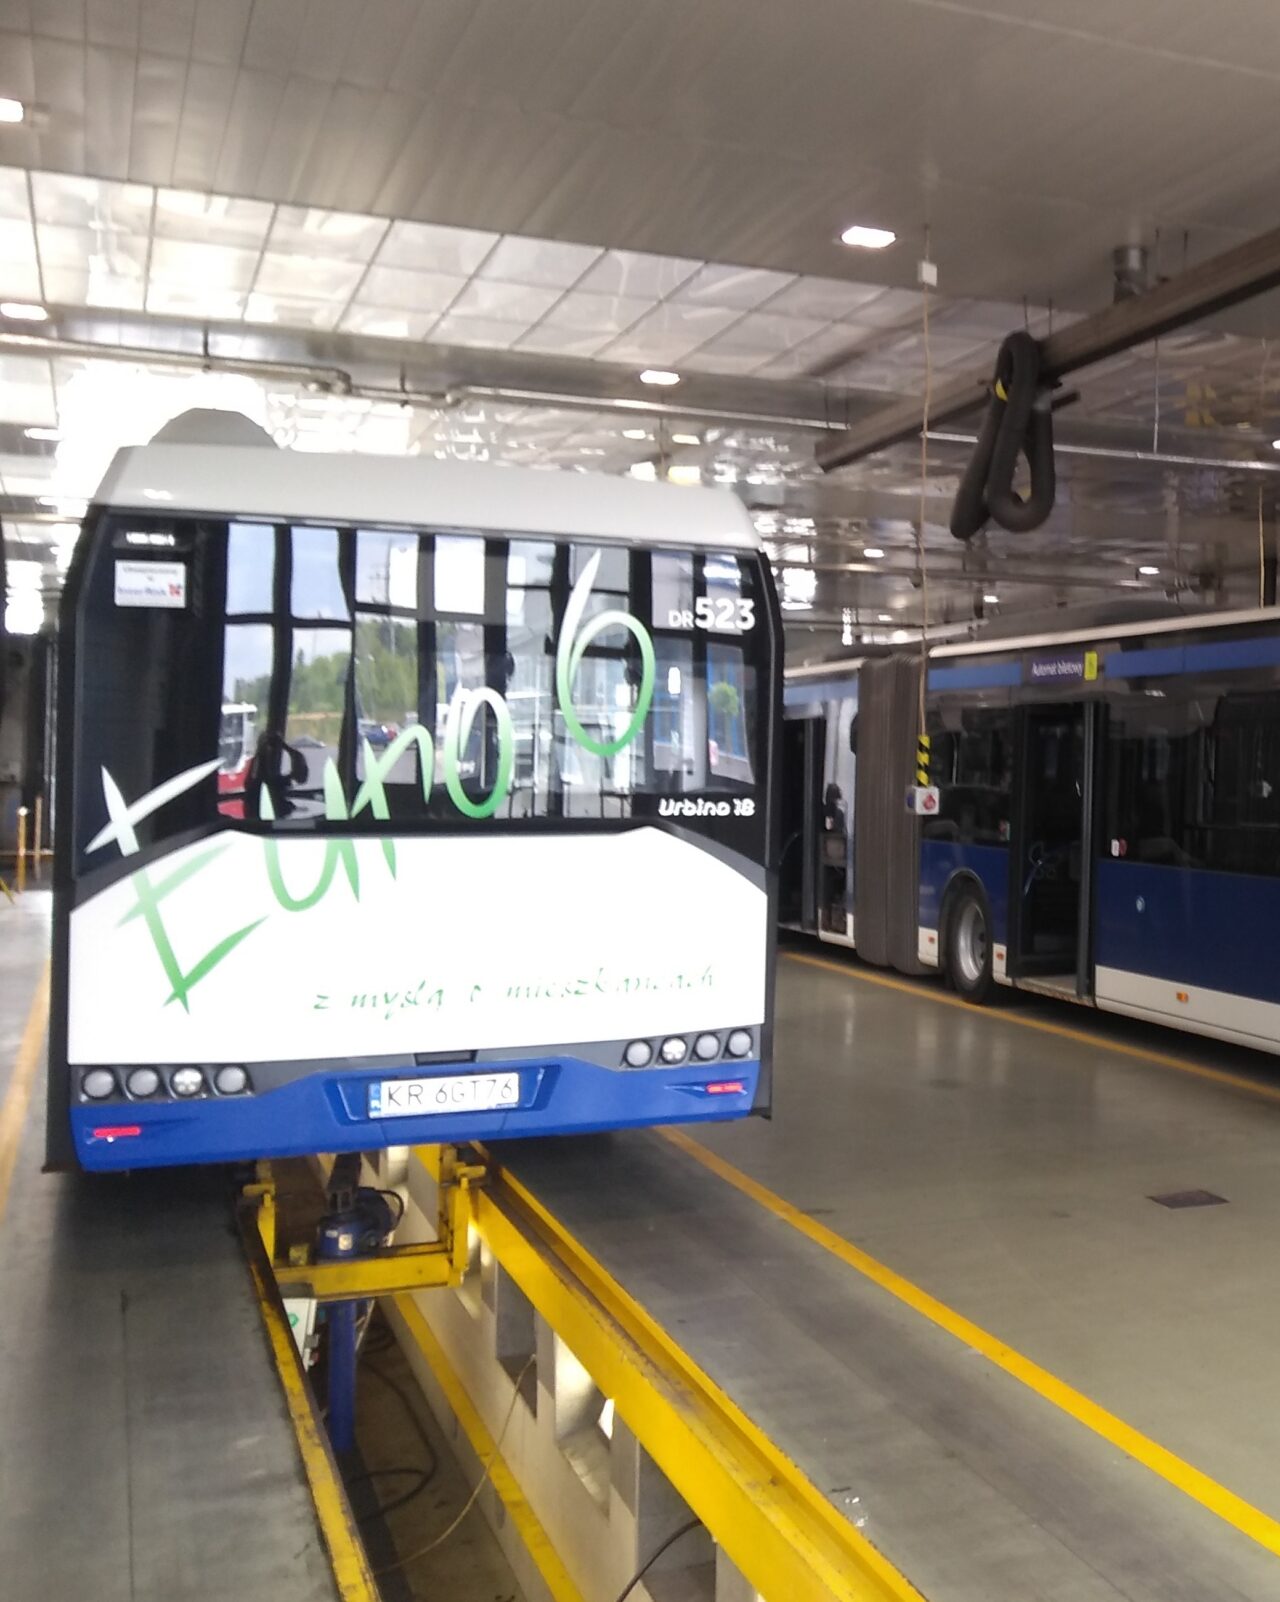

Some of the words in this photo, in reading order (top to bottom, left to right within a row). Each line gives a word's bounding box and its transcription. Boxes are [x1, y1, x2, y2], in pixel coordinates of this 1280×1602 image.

[668, 596, 755, 631] DR523
[84, 682, 515, 1016] Euro
[555, 547, 655, 757] 6
[658, 797, 731, 817] Urbino
[732, 797, 756, 817] 18
[387, 1084, 424, 1107] KR
[434, 1078, 514, 1105] 6GT76
